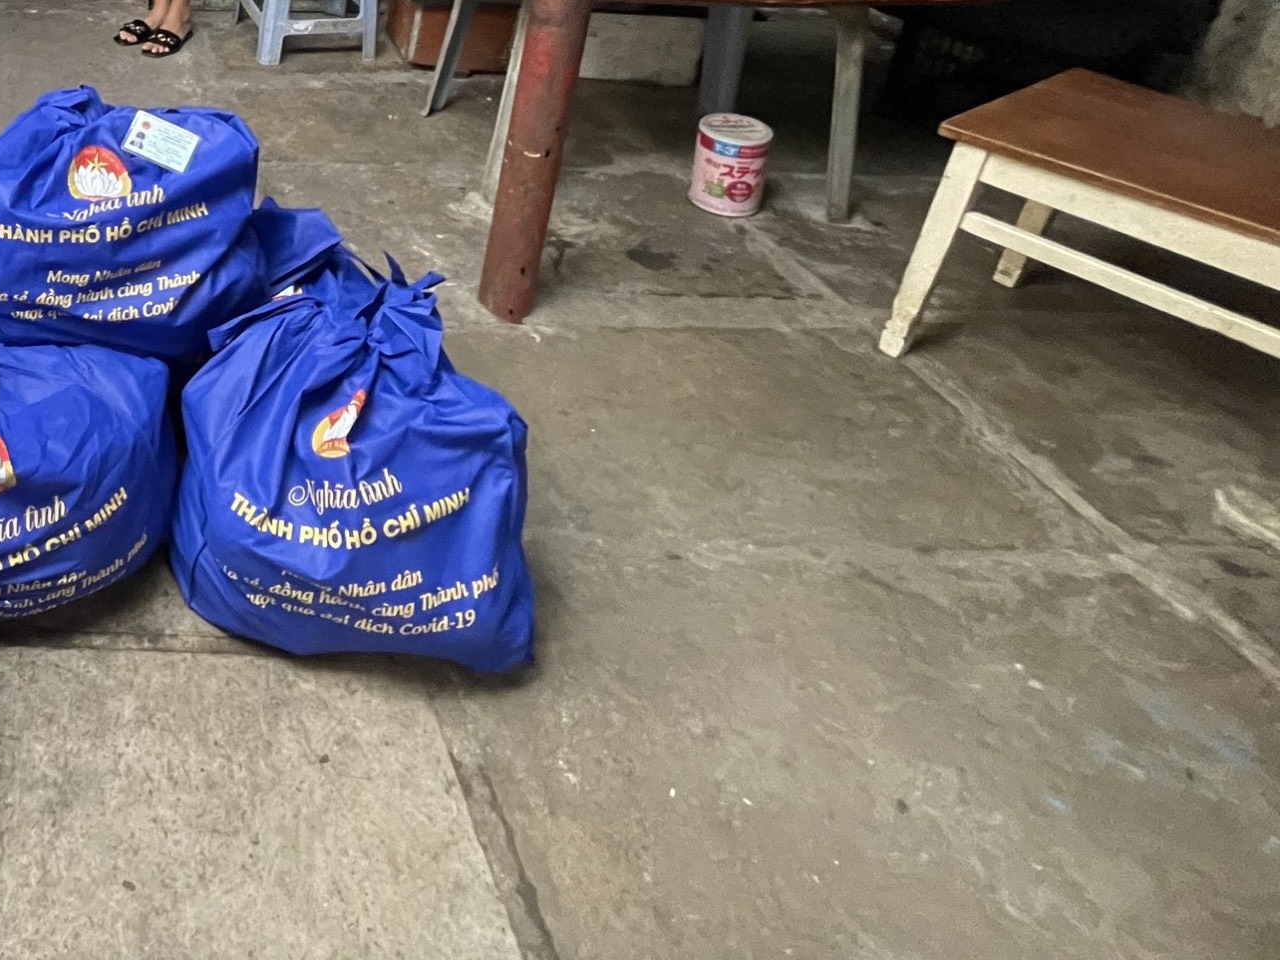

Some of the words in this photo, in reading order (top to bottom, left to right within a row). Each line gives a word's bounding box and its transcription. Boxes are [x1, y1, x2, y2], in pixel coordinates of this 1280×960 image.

[58, 221, 101, 244] PHỐ
[106, 216, 133, 242] HỒ
[166, 202, 209, 224] MINH
[35, 288, 73, 308] đồng
[117, 281, 153, 298] cùng
[47, 270, 90, 287] Mong
[142, 297, 179, 317] Covi
[84, 486, 130, 533] MINH
[288, 478, 360, 516] Nghĩa
[298, 520, 342, 550] PHỐ
[344, 517, 378, 551] HỒ
[382, 503, 421, 538] CHÍ
[424, 486, 471, 523] MINH
[337, 579, 388, 598] Nhân
[391, 569, 423, 592] dân
[371, 602, 416, 618] cùng
[419, 580, 470, 611] Thành
[354, 618, 395, 635] dịch
[399, 608, 477, 636] Covid-19
